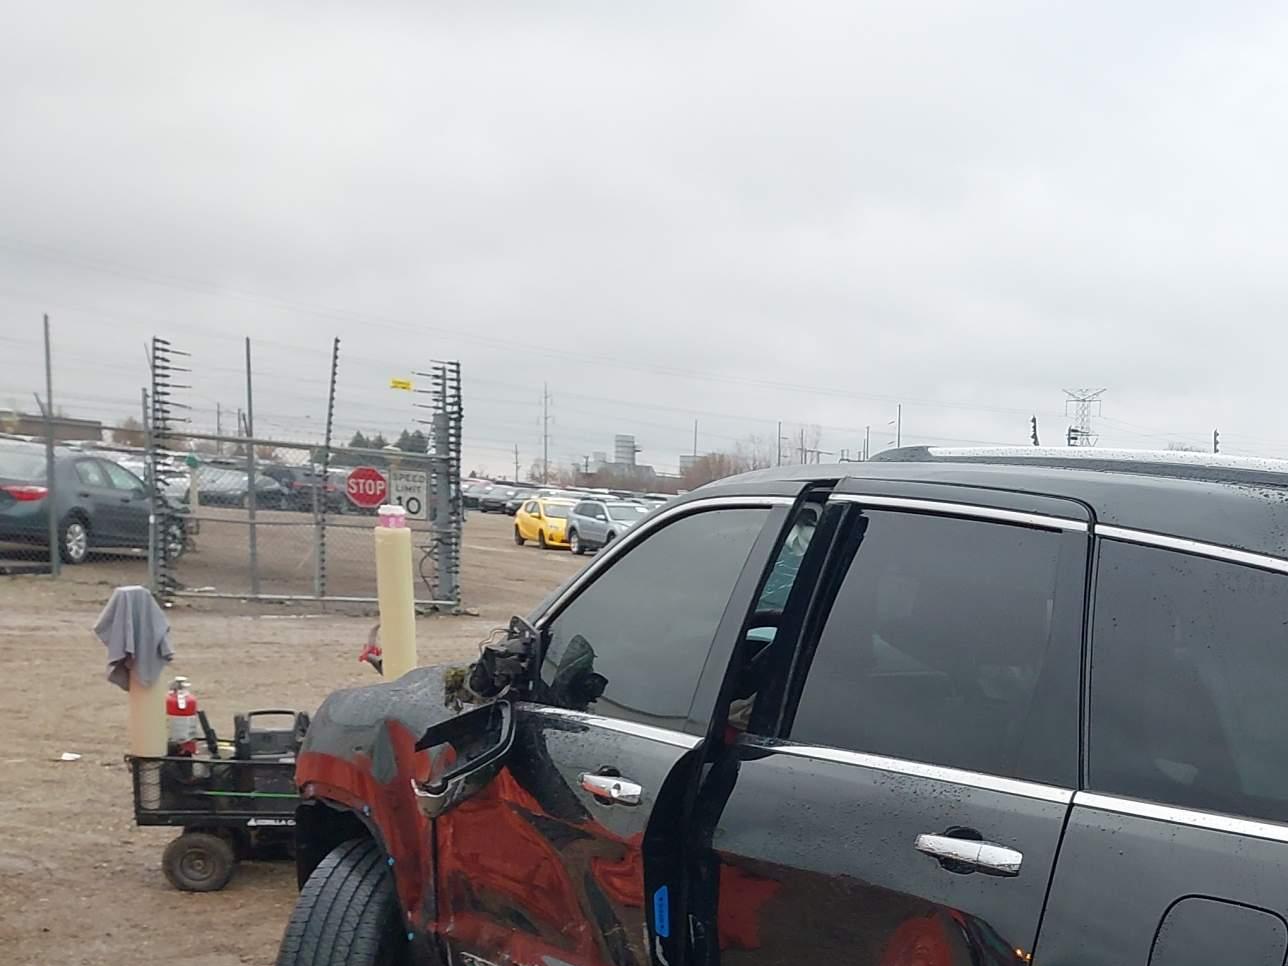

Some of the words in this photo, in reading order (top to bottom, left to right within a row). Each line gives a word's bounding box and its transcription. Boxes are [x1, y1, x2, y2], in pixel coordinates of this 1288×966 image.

[392, 472, 425, 483] SPEED
[348, 479, 386, 495] STOP
[395, 483, 422, 493] LIMIT
